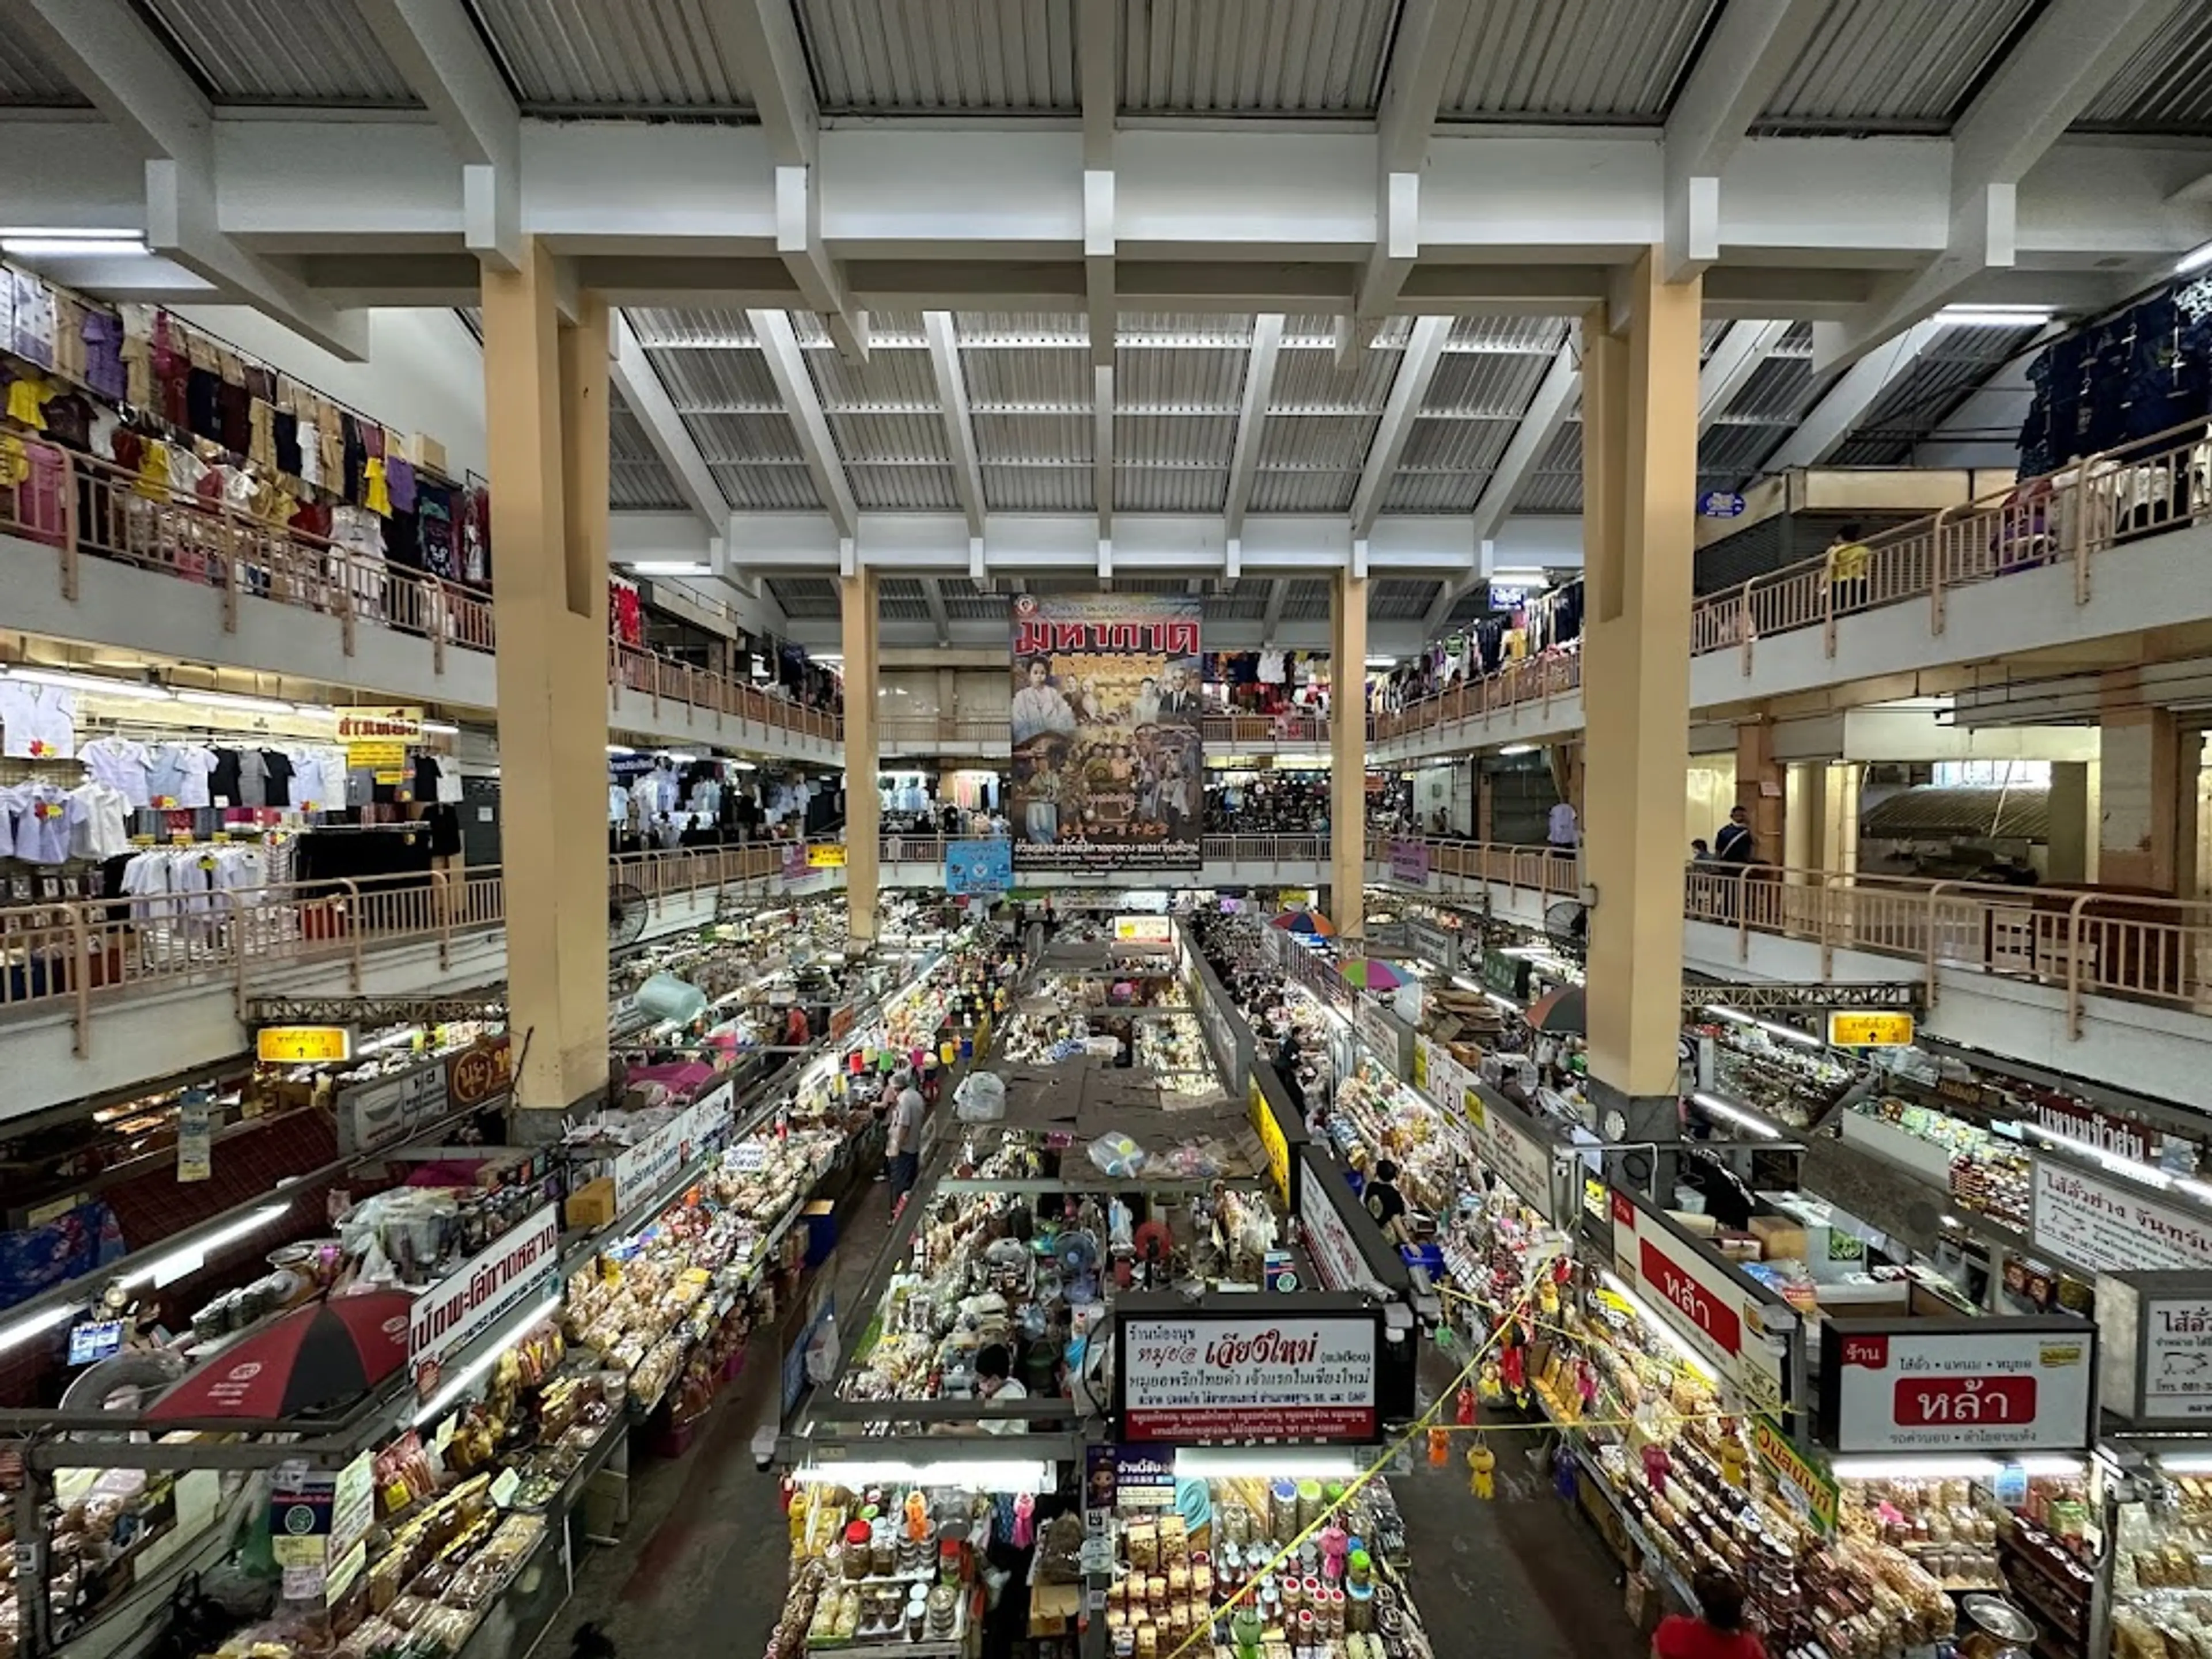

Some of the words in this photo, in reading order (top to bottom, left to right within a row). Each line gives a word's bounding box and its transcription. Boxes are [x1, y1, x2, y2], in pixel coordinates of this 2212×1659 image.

[1014, 618, 1201, 656] มหากาด
[2041, 1169, 2126, 1218] ไส้อั่วย่าง
[2135, 1208, 2212, 1251] จันทร์เ
[1663, 1271, 1711, 1330] หล้า
[1129, 1324, 1195, 1344] ร้านน้องนุช
[1846, 1344, 1880, 1361] ร้าน
[1900, 1355, 1930, 1370] ไส้อั่ว
[1944, 1361, 1982, 1370] แหนม
[1997, 1359, 2032, 1372] หมูยอ
[1129, 1369, 1241, 1393] หมูยอพริกไทยดำ
[1245, 1367, 1370, 1385] เจ้าแรกในเชียงใหม่
[1918, 1378, 2008, 1421] หล้า
[1963, 1428, 2037, 1443] ลำไยอบแห้ง
